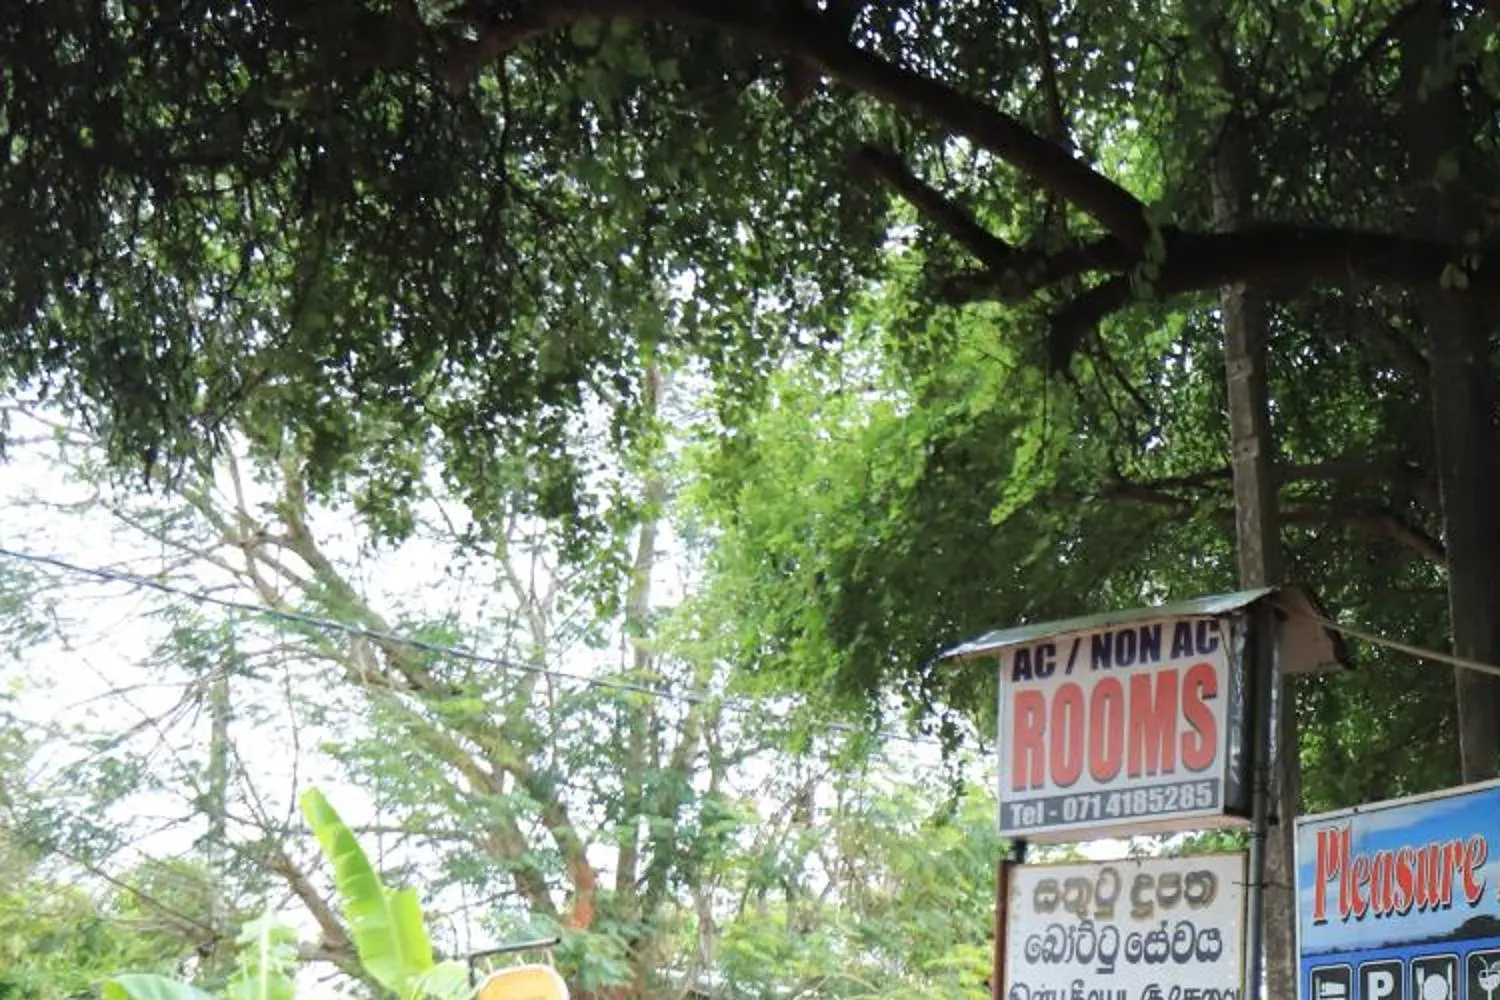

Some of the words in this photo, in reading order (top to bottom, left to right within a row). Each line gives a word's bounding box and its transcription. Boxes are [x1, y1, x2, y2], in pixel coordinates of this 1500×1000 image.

[1011, 641, 1056, 682] AC
[1065, 637, 1080, 675] /
[1091, 623, 1162, 671] NON
[1171, 620, 1220, 659] AC
[1011, 662, 1218, 792] ROOMS
[1011, 801, 1044, 828] Tel
[1312, 823, 1489, 924] Pleasure
[1125, 920, 1223, 965] සේවය
